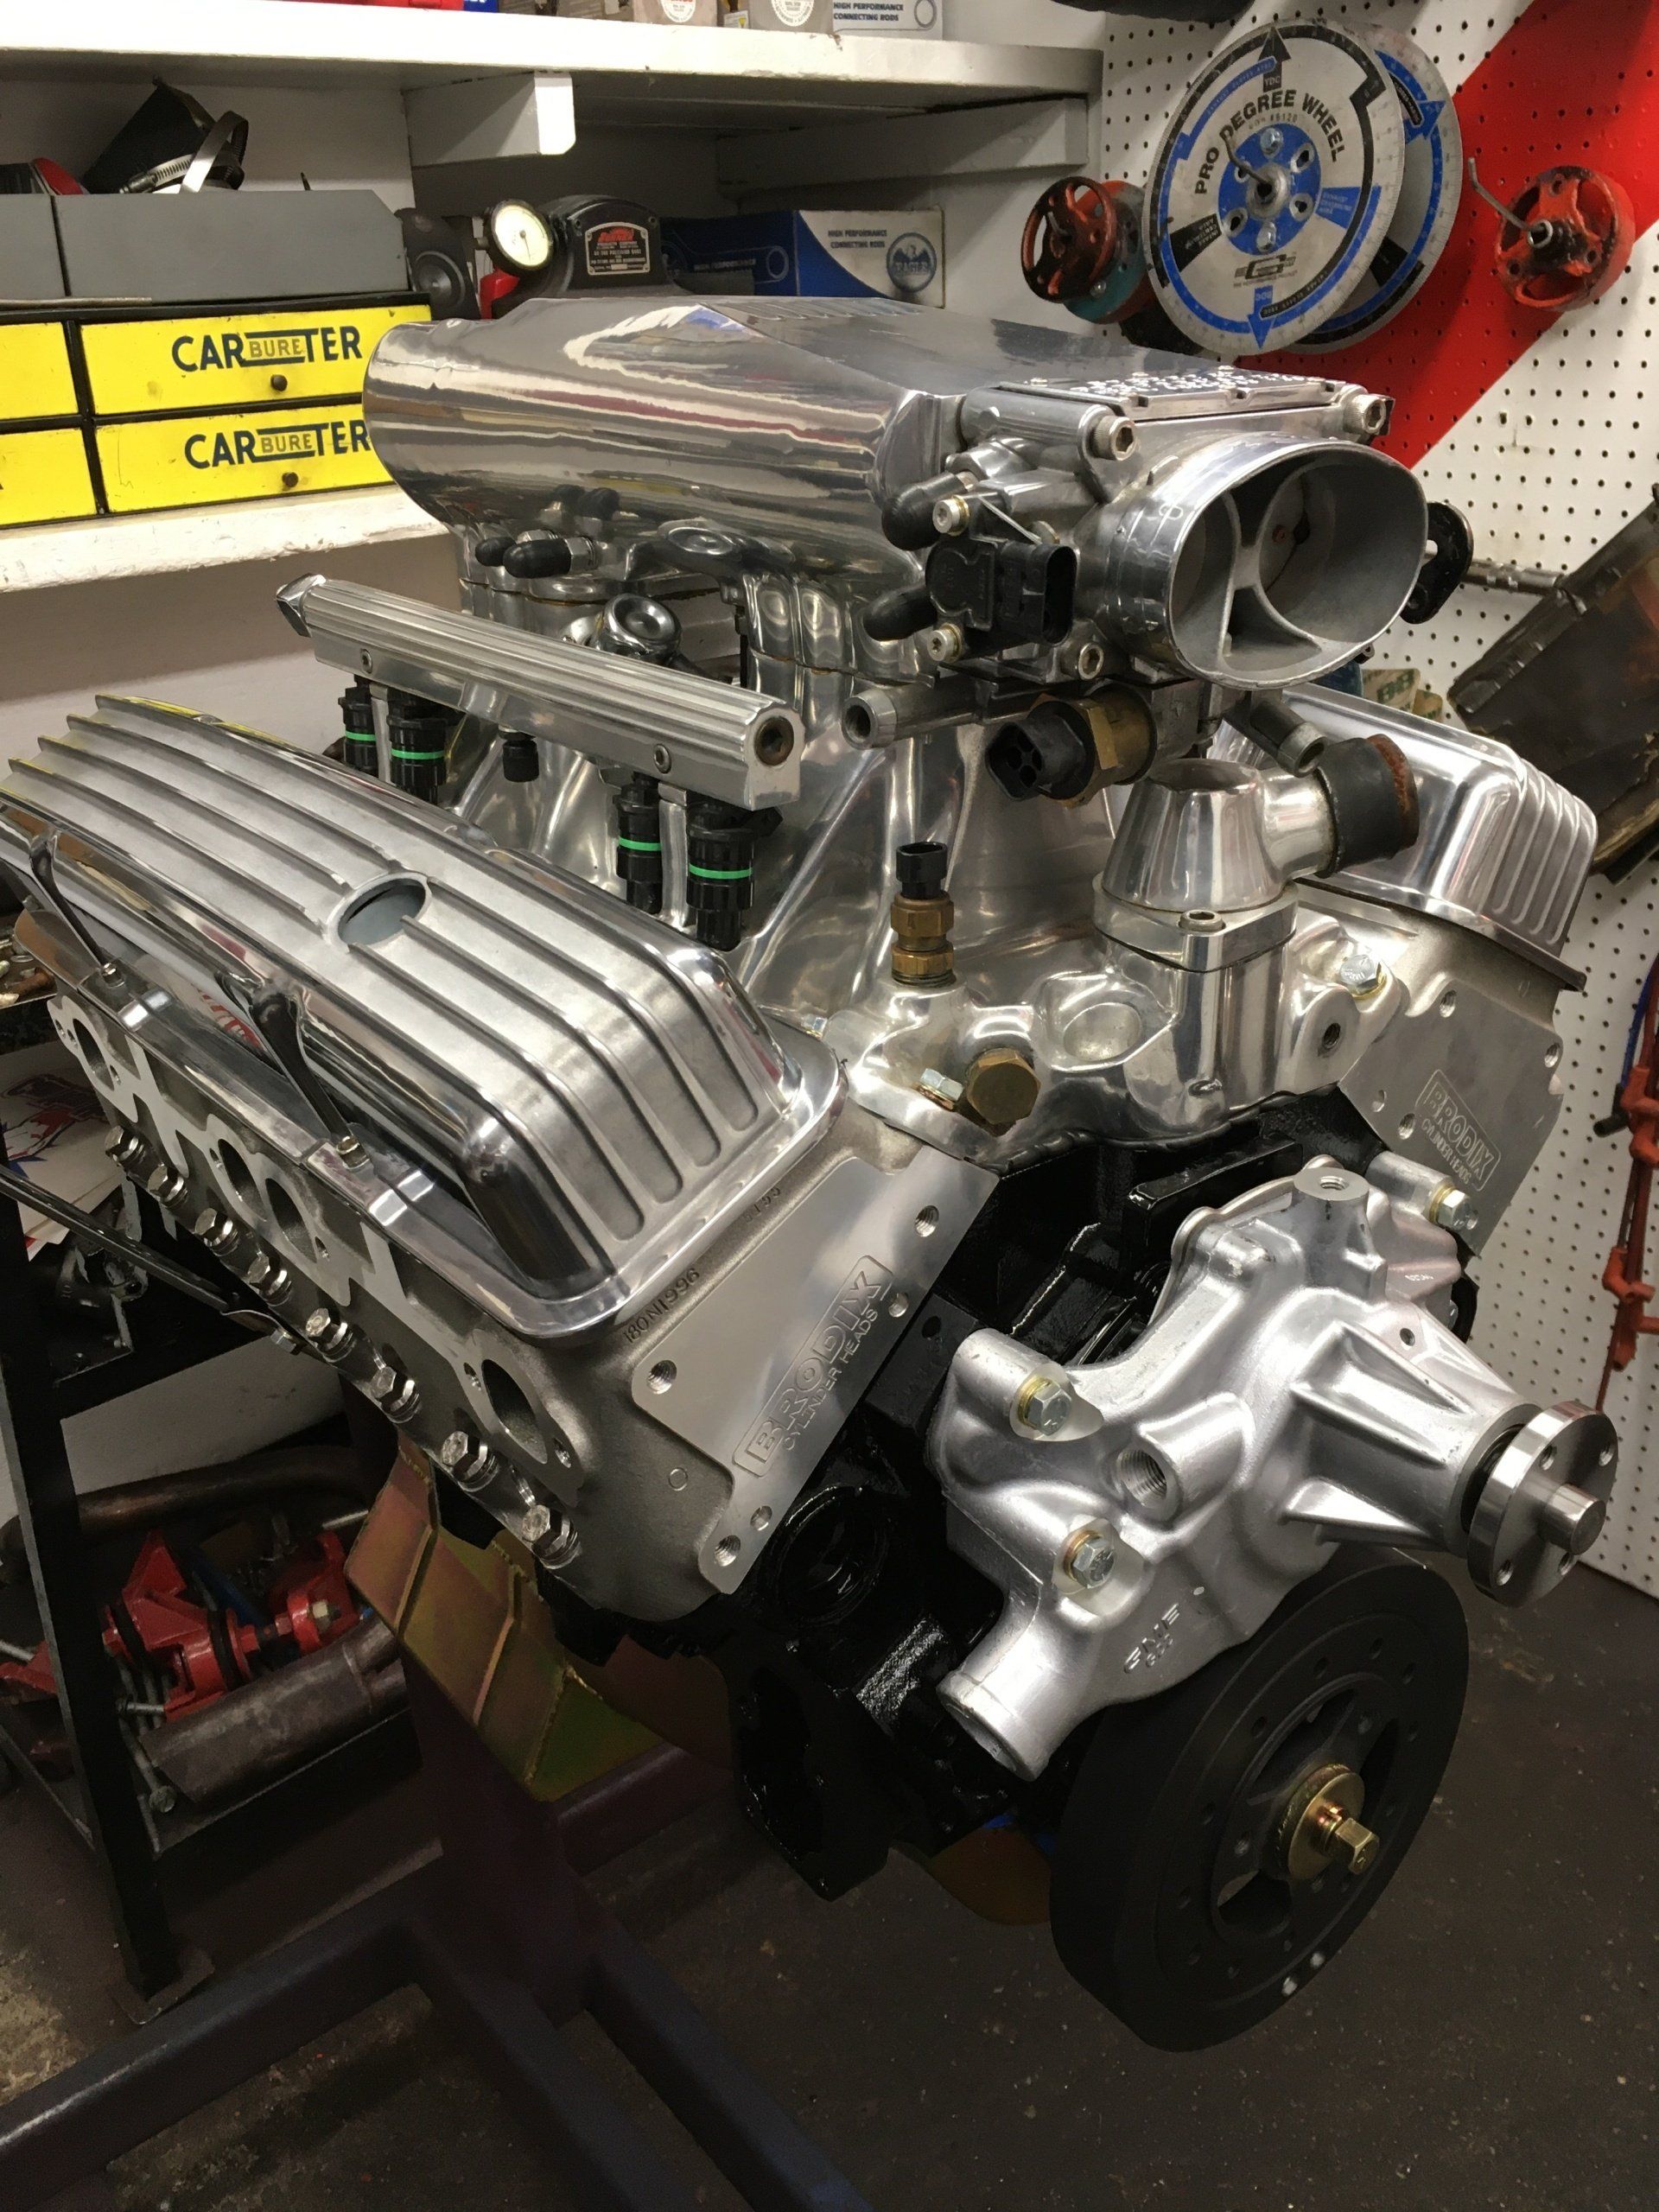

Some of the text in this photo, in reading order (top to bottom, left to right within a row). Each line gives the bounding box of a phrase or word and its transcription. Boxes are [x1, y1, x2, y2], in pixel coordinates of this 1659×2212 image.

[853, 3, 904, 11] PERFORMANCE
[1194, 146, 1220, 194] PRO
[1219, 89, 1297, 141] DEGREE
[1302, 92, 1345, 162] WHEEL
[1424, 1081, 1496, 1180] BRODIX
[746, 1269, 884, 1463] BRODIX
[783, 1309, 879, 1452] CYLINDER HEADS
